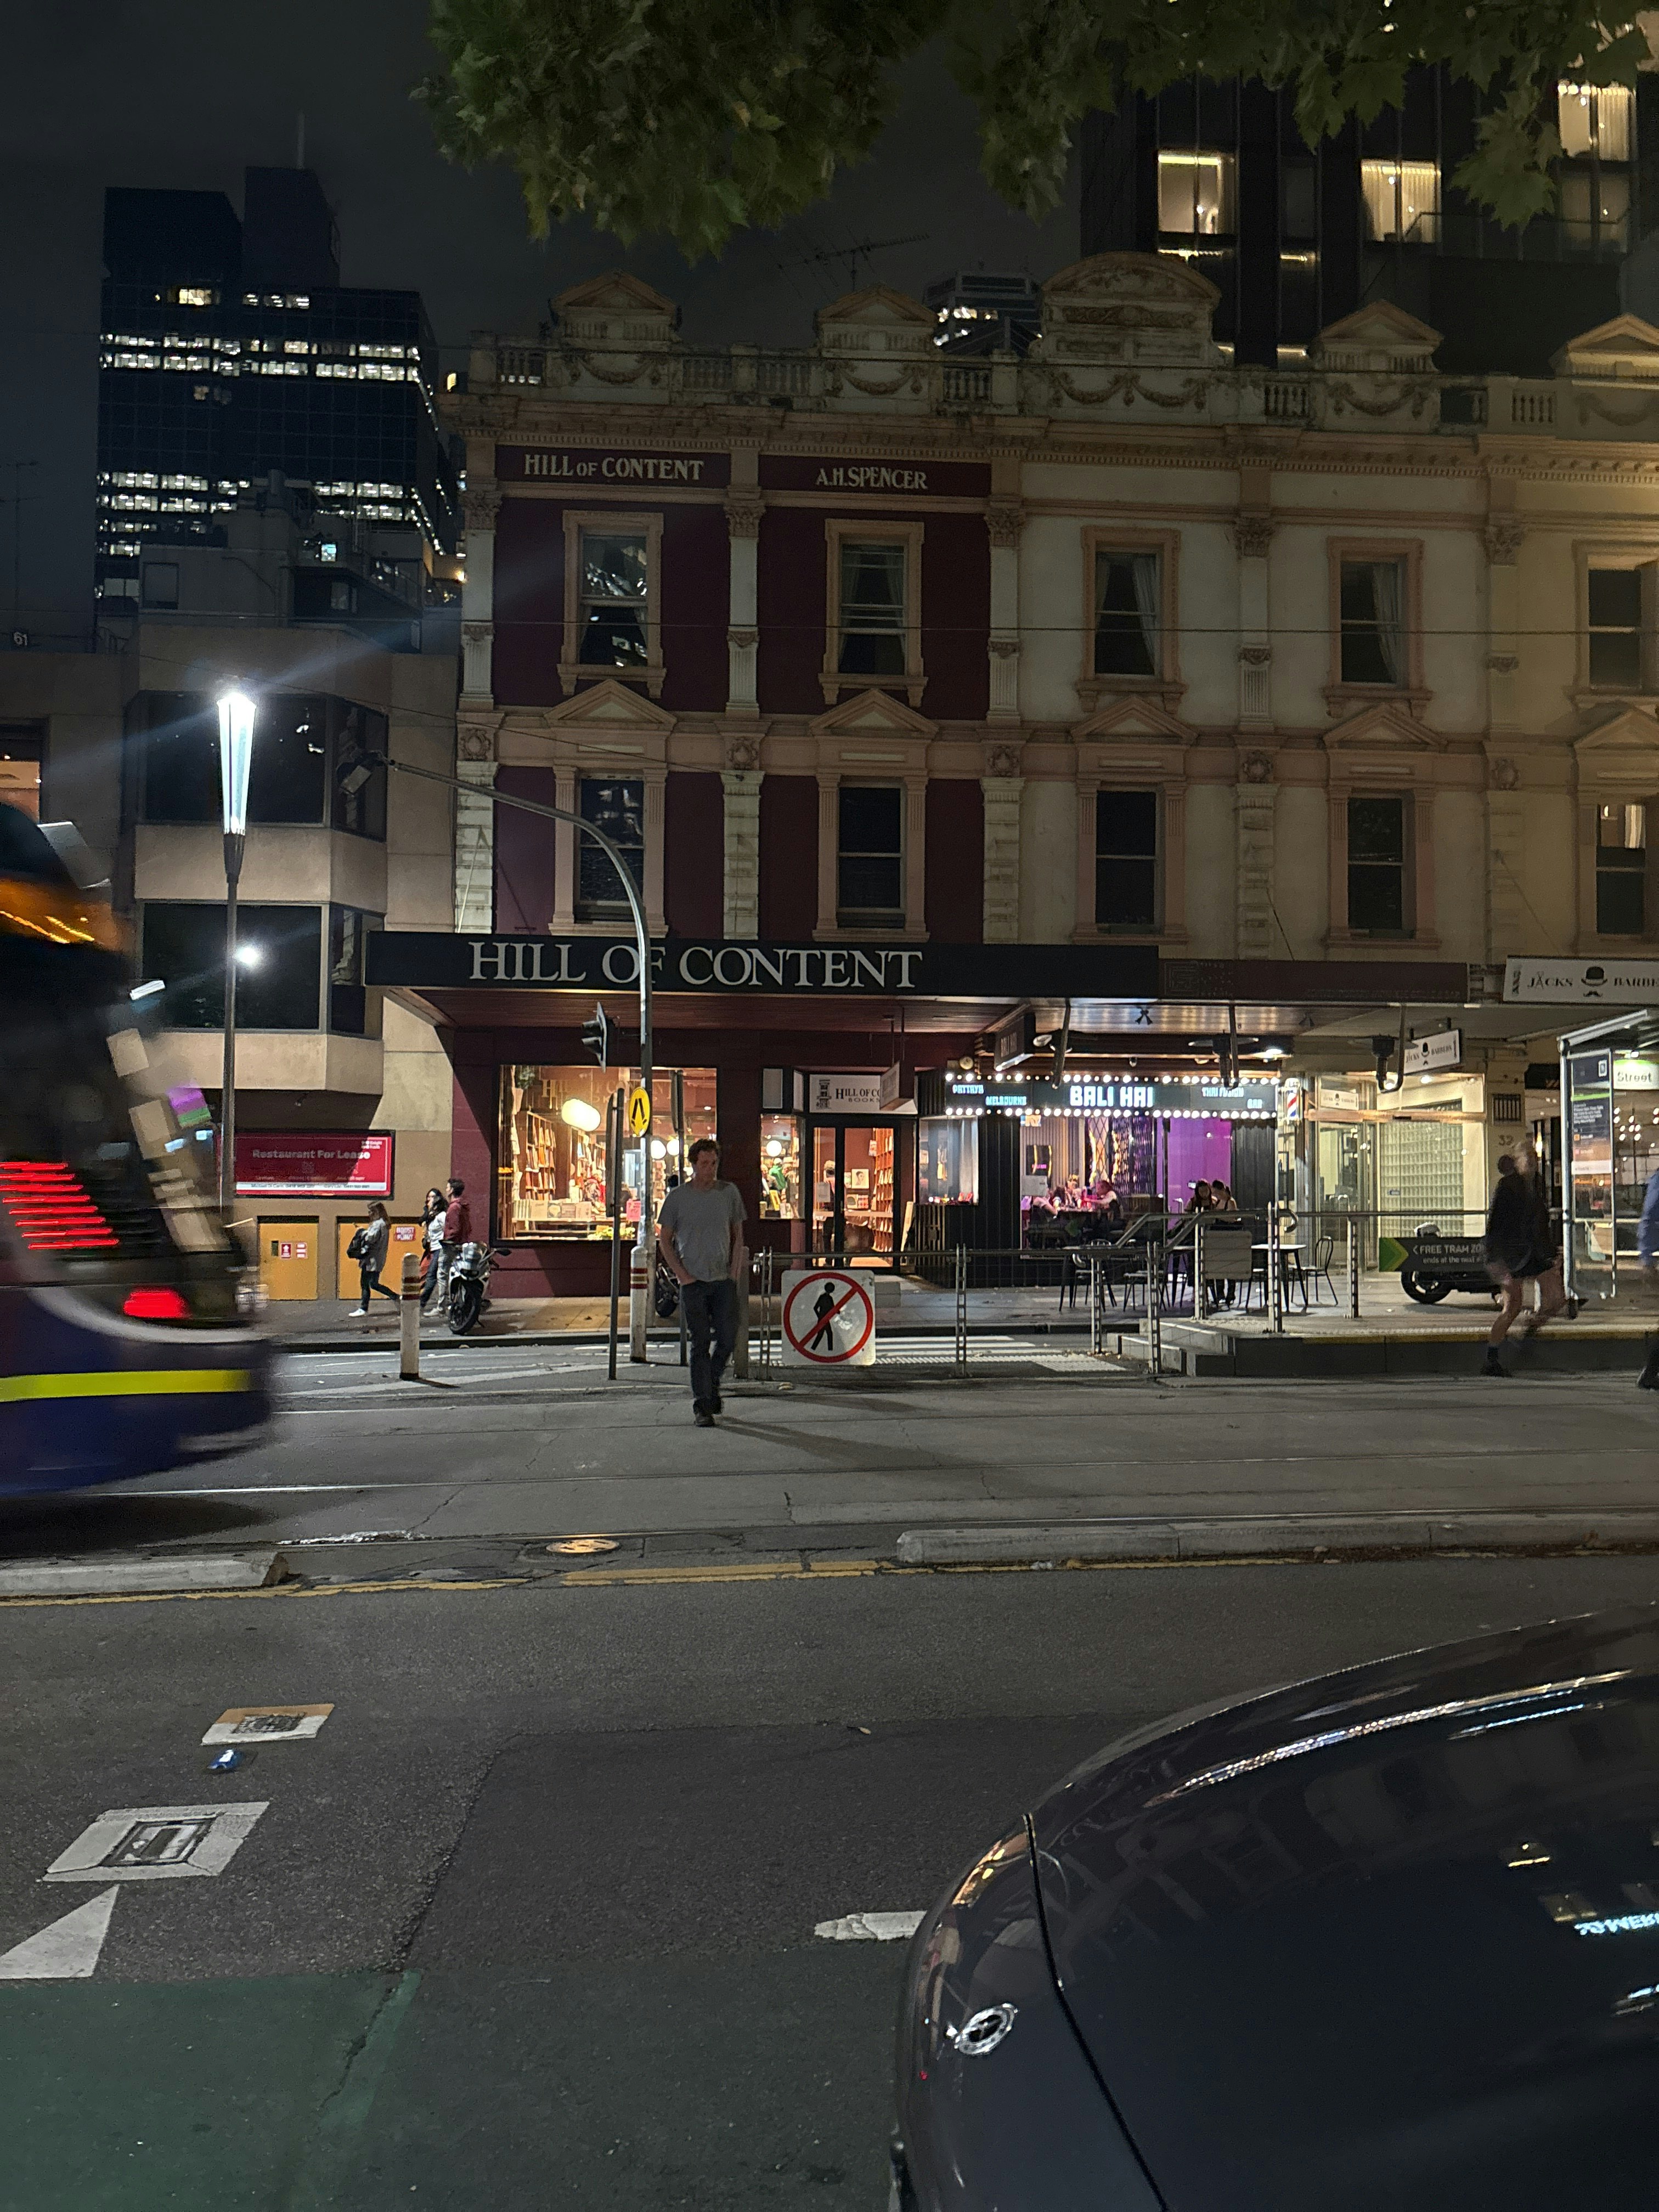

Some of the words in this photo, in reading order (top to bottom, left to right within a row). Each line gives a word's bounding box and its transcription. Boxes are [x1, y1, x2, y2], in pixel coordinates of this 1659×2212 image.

[524, 454, 573, 477] HILL
[577, 462, 596, 477] OF
[601, 457, 704, 481] CONTENT
[469, 941, 586, 982] HILL
[679, 946, 923, 988] CONTENT
[1617, 1070, 1653, 1083] Street
[835, 1088, 858, 1099] HILL
[859, 1088, 871, 1097] OF
[952, 1084, 984, 1094] PATTAYA
[985, 1096, 1026, 1106] MELBOURNE
[1070, 1086, 1114, 1107] BALI
[1120, 1086, 1154, 1108] HAI
[252, 1149, 315, 1159] Restaurant
[318, 1150, 335, 1159] For
[337, 1150, 371, 1159] Lease
[1420, 1245, 1442, 1255] FREE
[1444, 1244, 1469, 1254] TRAM
[1423, 1256, 1440, 1265] ends
[1448, 1256, 1460, 1264] the
